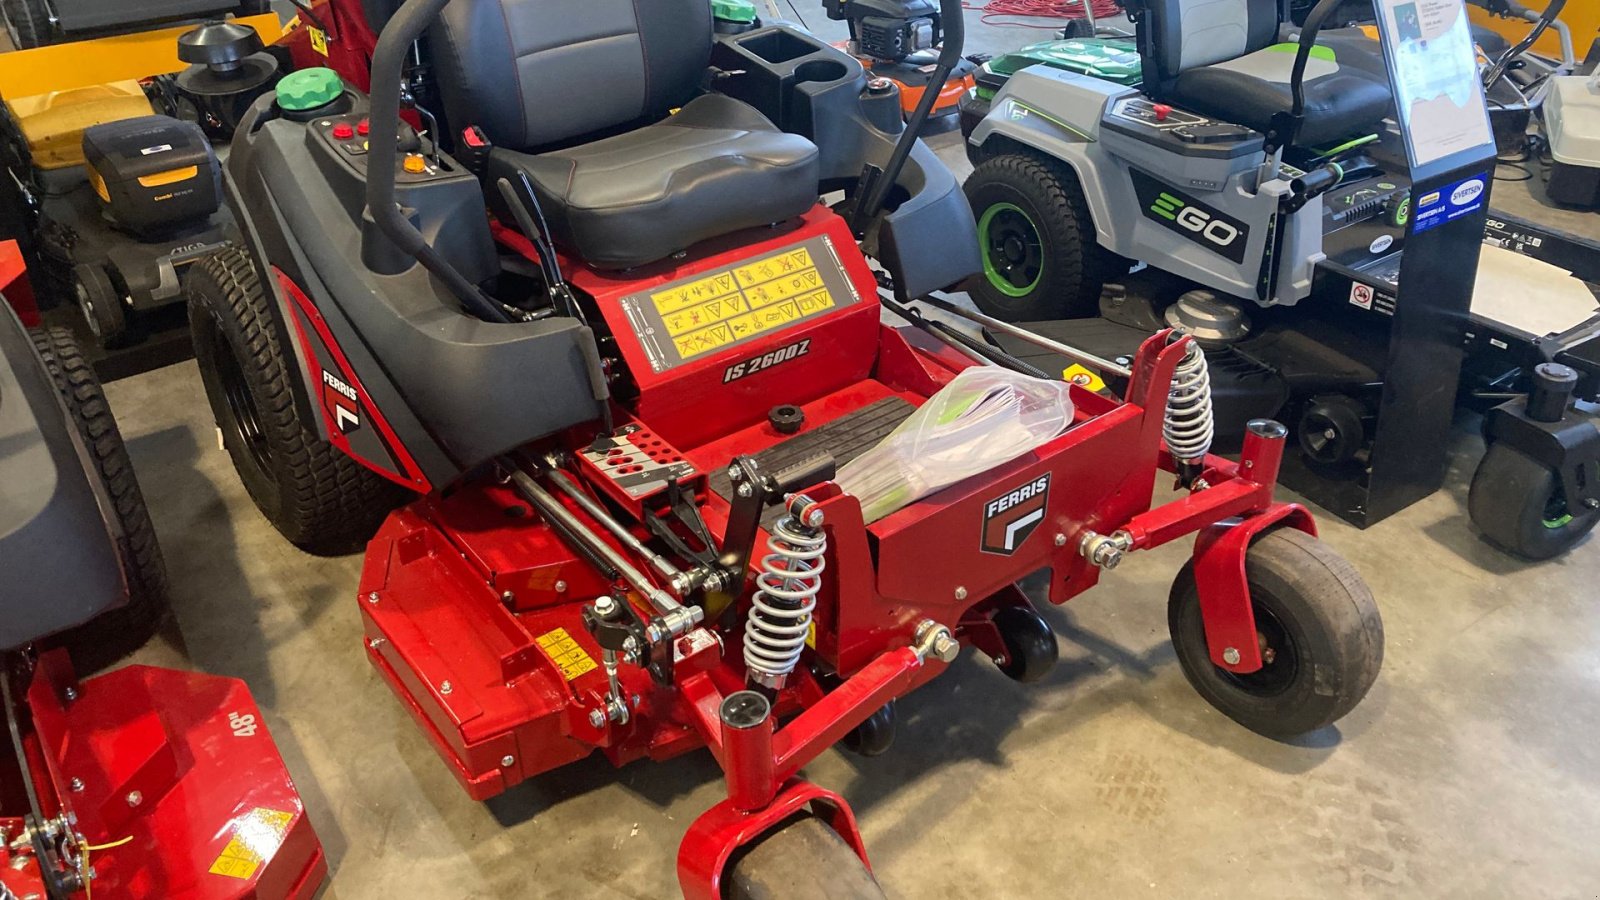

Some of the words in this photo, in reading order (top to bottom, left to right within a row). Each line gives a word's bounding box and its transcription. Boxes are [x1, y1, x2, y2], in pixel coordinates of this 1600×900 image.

[1452, 184, 1482, 201] SIVERTSEN
[1150, 192, 1238, 246] EGO
[724, 362, 746, 383] IS
[747, 339, 811, 374] 2600Z
[323, 370, 357, 401] FERRIS
[988, 477, 1048, 518] FERRIS
